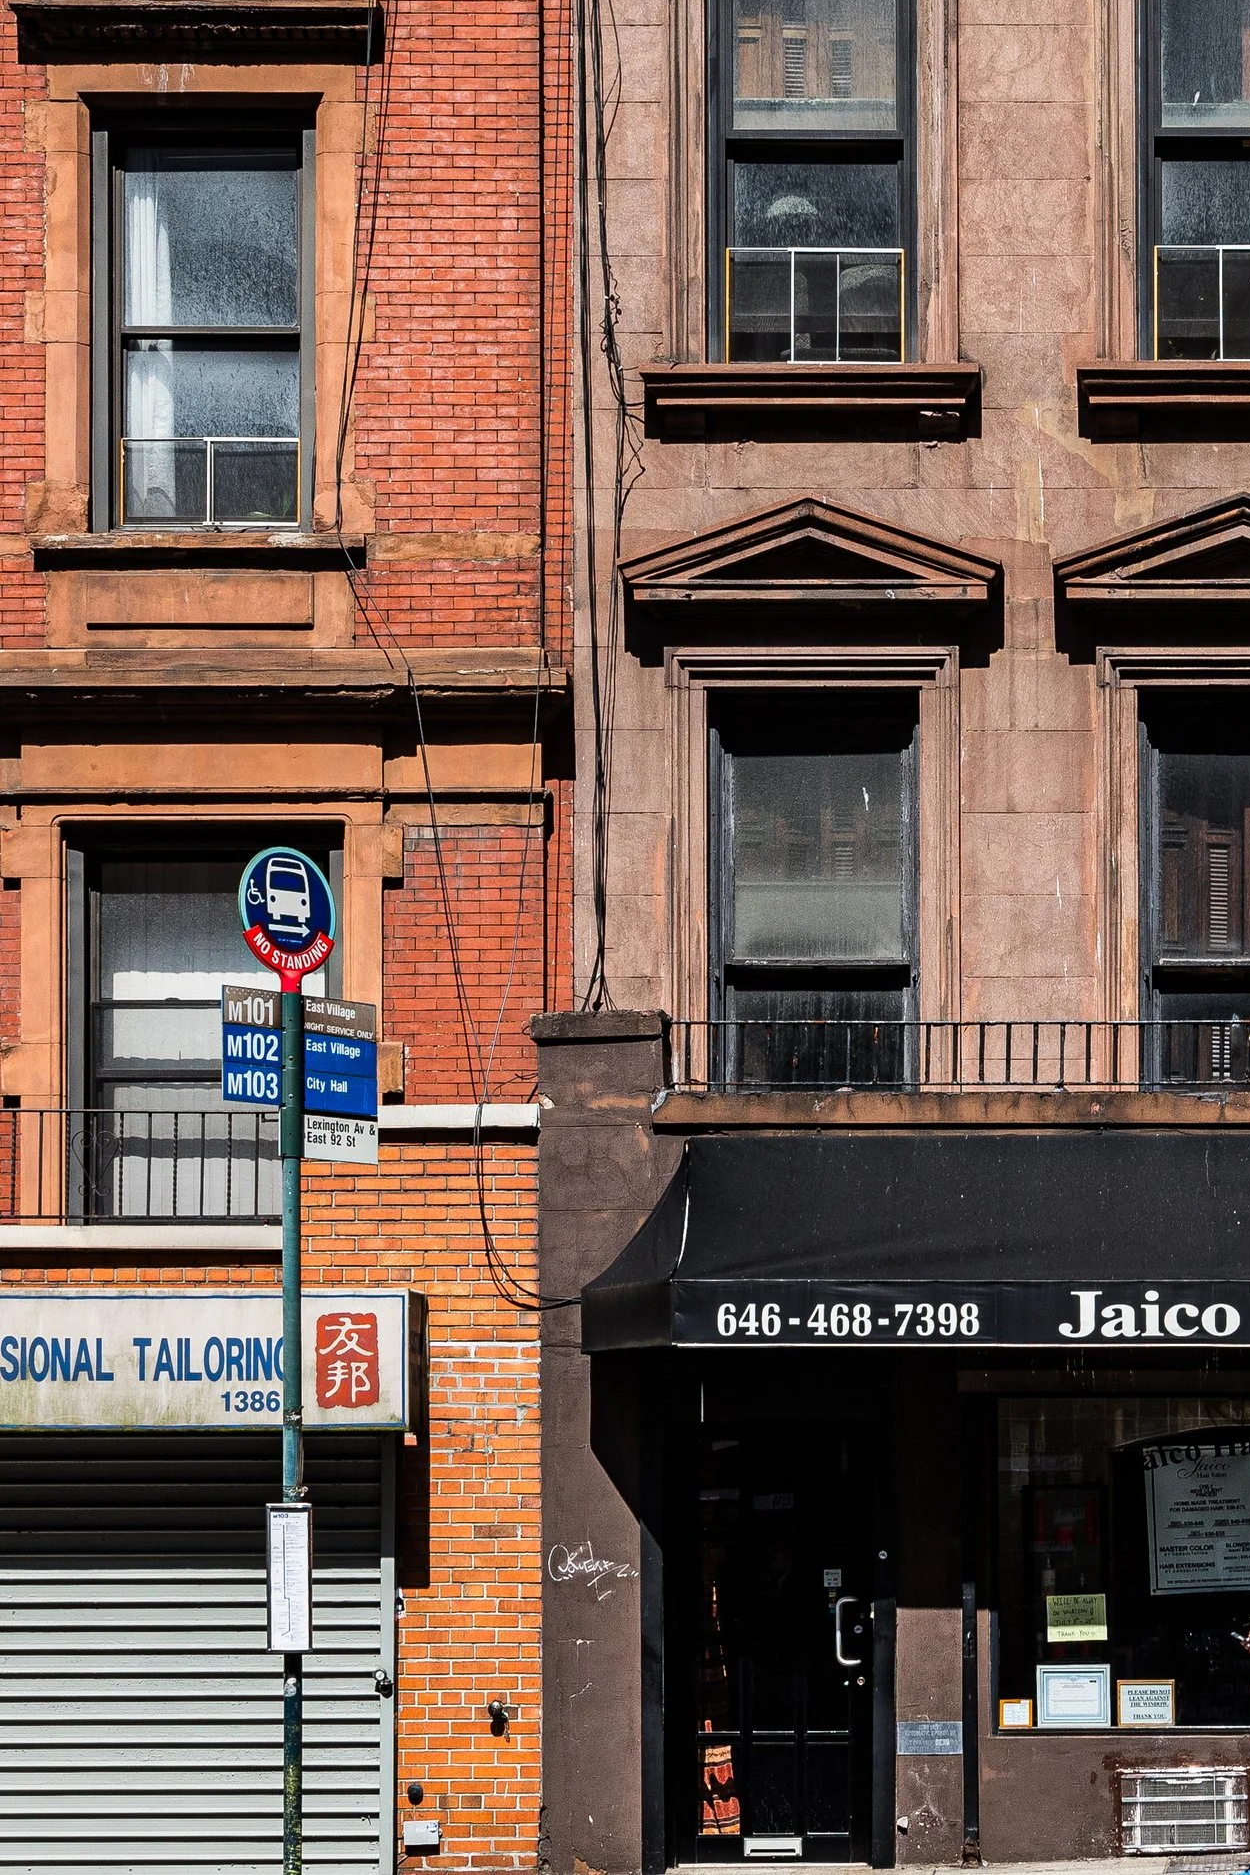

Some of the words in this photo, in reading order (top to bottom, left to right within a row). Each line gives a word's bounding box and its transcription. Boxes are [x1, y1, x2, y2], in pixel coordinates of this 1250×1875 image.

[253, 931, 271, 955] NO
[271, 939, 329, 970] STANDING
[228, 996, 275, 1026] M101
[305, 999, 325, 1014] East
[326, 1002, 356, 1019] Village
[304, 1022, 324, 1032] NIGHT
[326, 1025, 354, 1037] SERVICE
[356, 1029, 374, 1040] ONLY
[227, 1031, 279, 1062] M102
[306, 1038, 327, 1053] East
[330, 1041, 361, 1059] Village
[227, 1070, 279, 1099] M103
[306, 1076, 326, 1093] City
[330, 1079, 348, 1093] Hall
[307, 1117, 350, 1134] Lexington
[353, 1123, 365, 1134] Av
[369, 1124, 376, 1136] &
[307, 1131, 327, 1145] East
[330, 1133, 342, 1146] 92
[346, 1135, 356, 1148] St
[1058, 1289, 1241, 1339] Jaico
[0, 1335, 115, 1382] SIONAL
[320, 1317, 375, 1404] 友邦
[221, 1390, 281, 1413] 1386
[1159, 1545, 1189, 1553] MASTER
